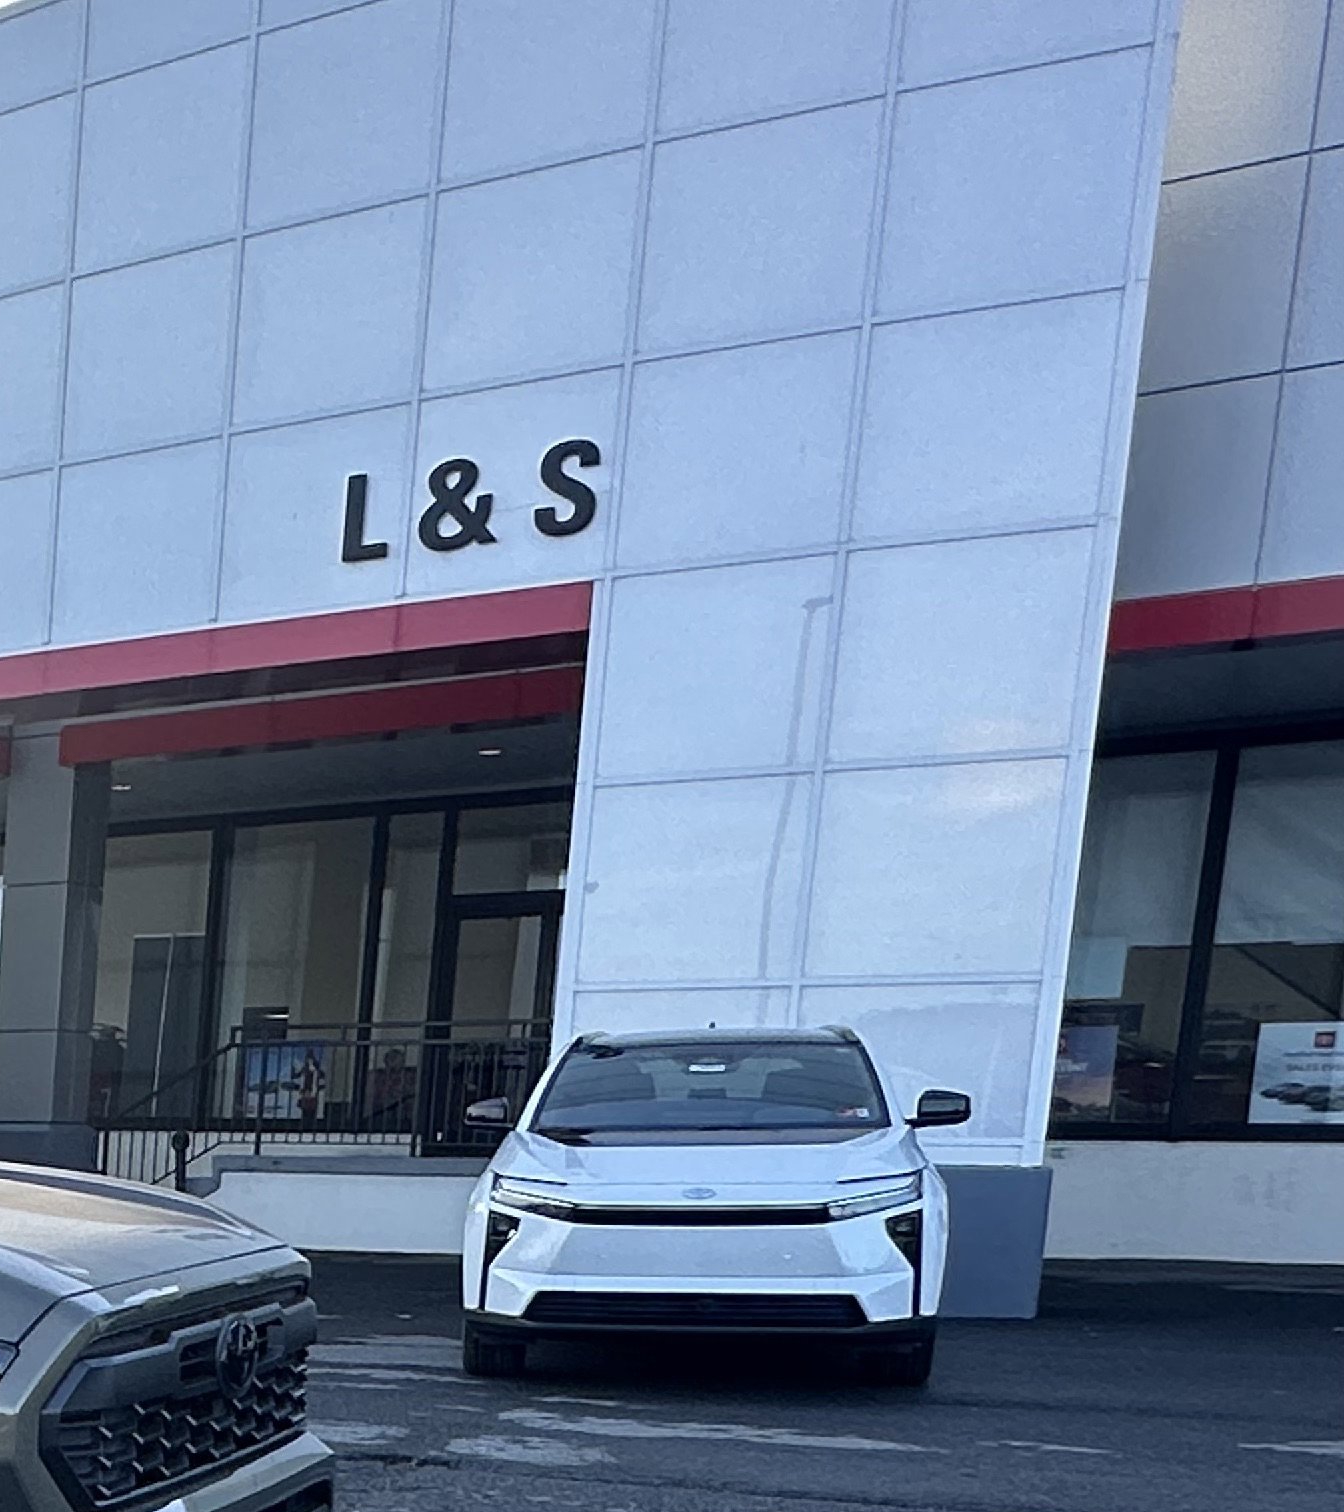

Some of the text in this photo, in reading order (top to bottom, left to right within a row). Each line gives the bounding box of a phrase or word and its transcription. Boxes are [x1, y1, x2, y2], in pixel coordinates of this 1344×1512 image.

[341, 439, 601, 562] L & S
